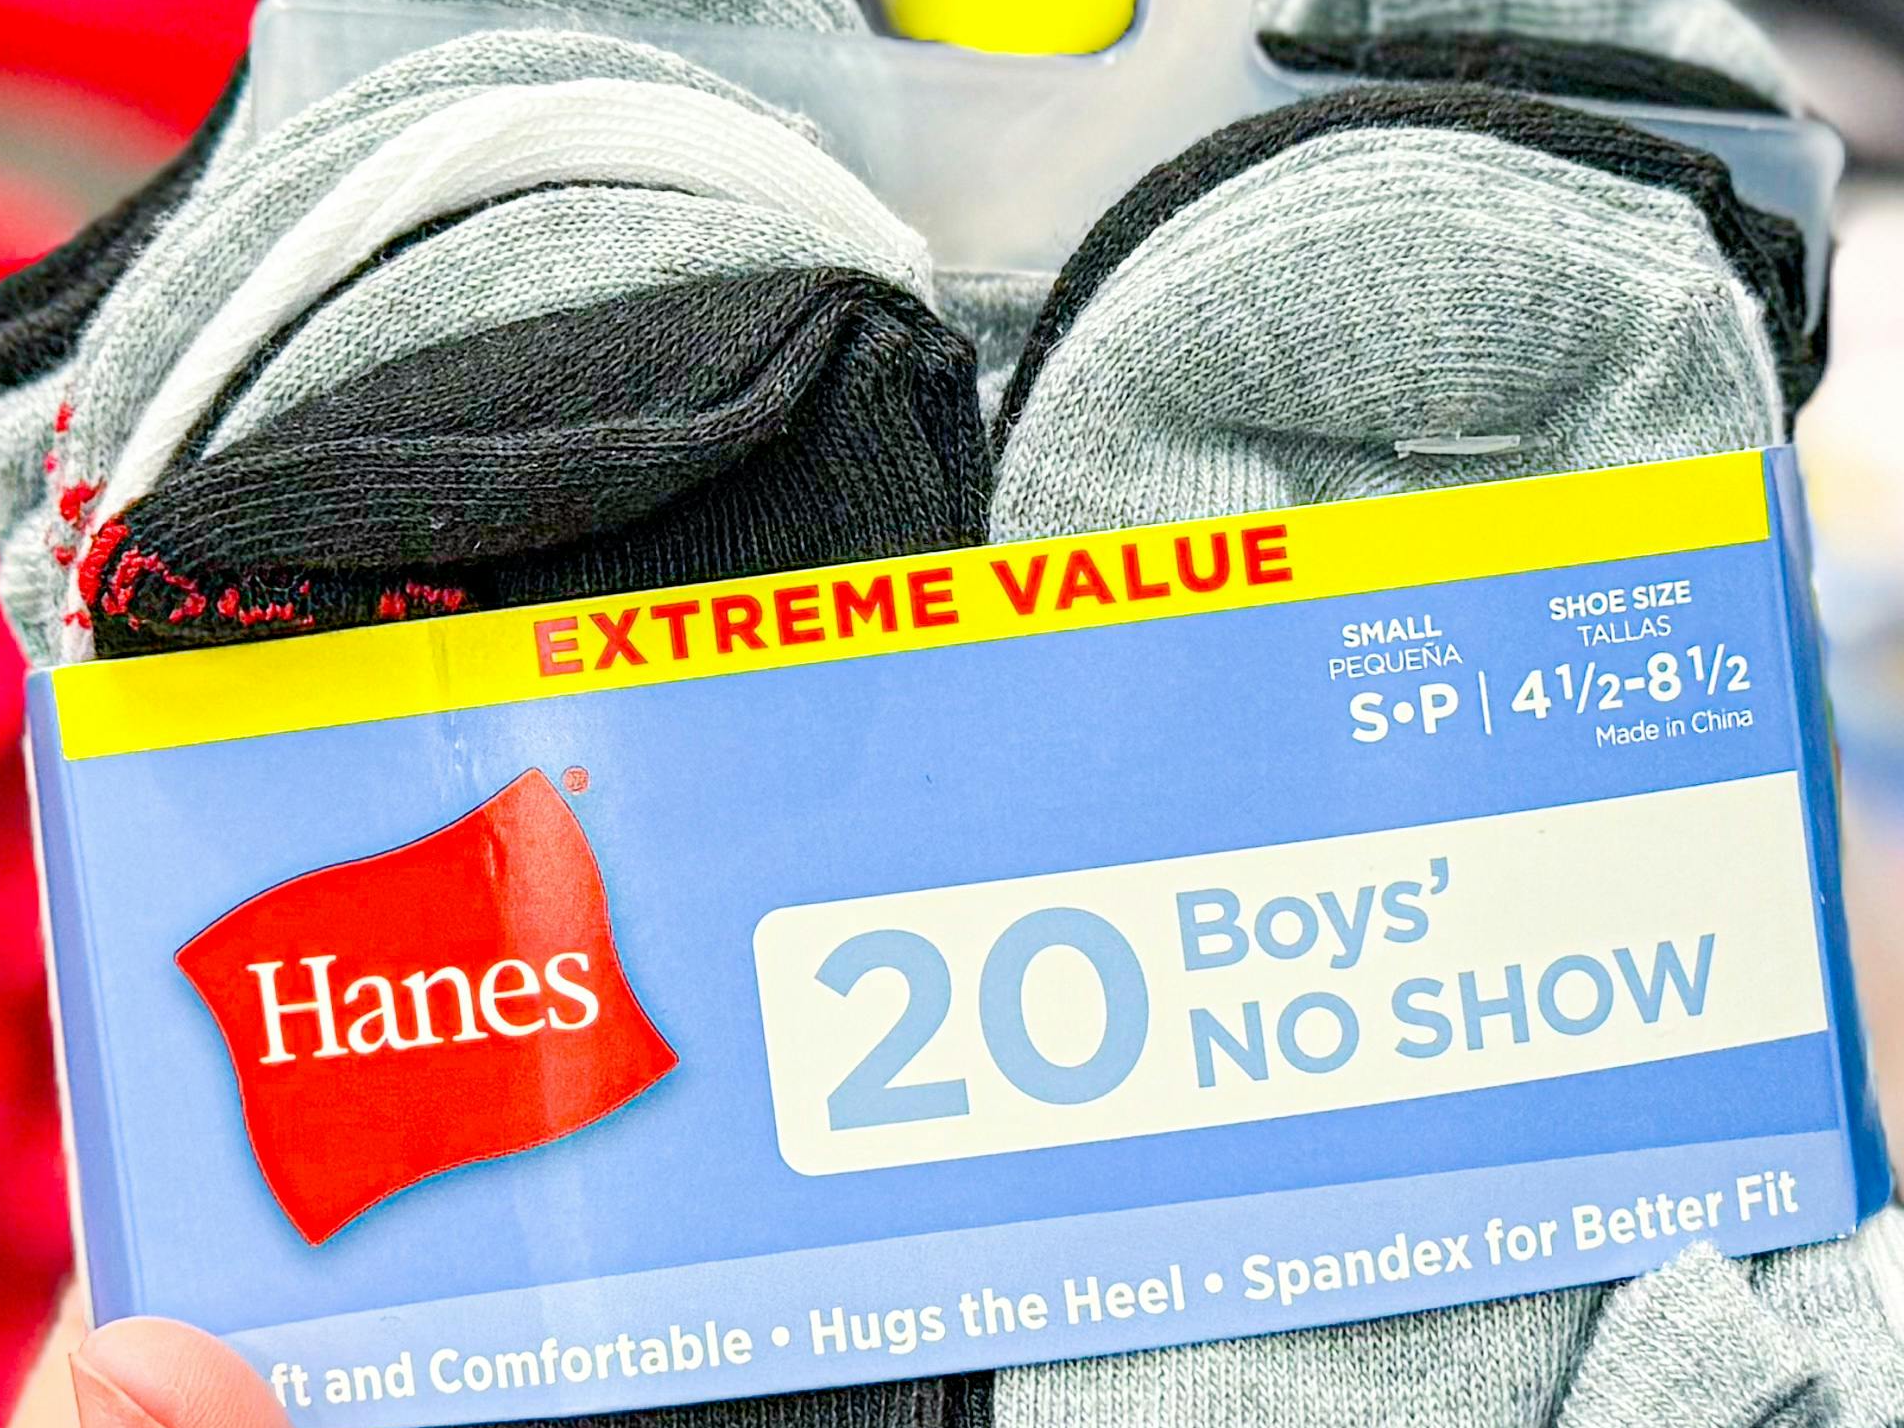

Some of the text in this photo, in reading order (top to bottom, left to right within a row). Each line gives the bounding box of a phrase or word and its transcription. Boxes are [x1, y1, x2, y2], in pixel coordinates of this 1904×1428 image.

[532, 567, 959, 678] EXTREME
[990, 523, 1294, 616] VALUE
[1342, 614, 1443, 648] SMALL
[1549, 580, 1693, 621] SHOE SIZE
[1577, 615, 1672, 647] TALLAS
[1329, 642, 1463, 681] PEQUEÑA
[1596, 707, 1754, 748] Made in China
[1176, 856, 1451, 972] Boys’
[246, 951, 600, 1065] Hanes
[814, 906, 1151, 1133] 20
[1189, 933, 1717, 1089] NO SHOW
[270, 1170, 1800, 1408] ft and Comfortable Hugs the Heel Spandex for Better Fit
